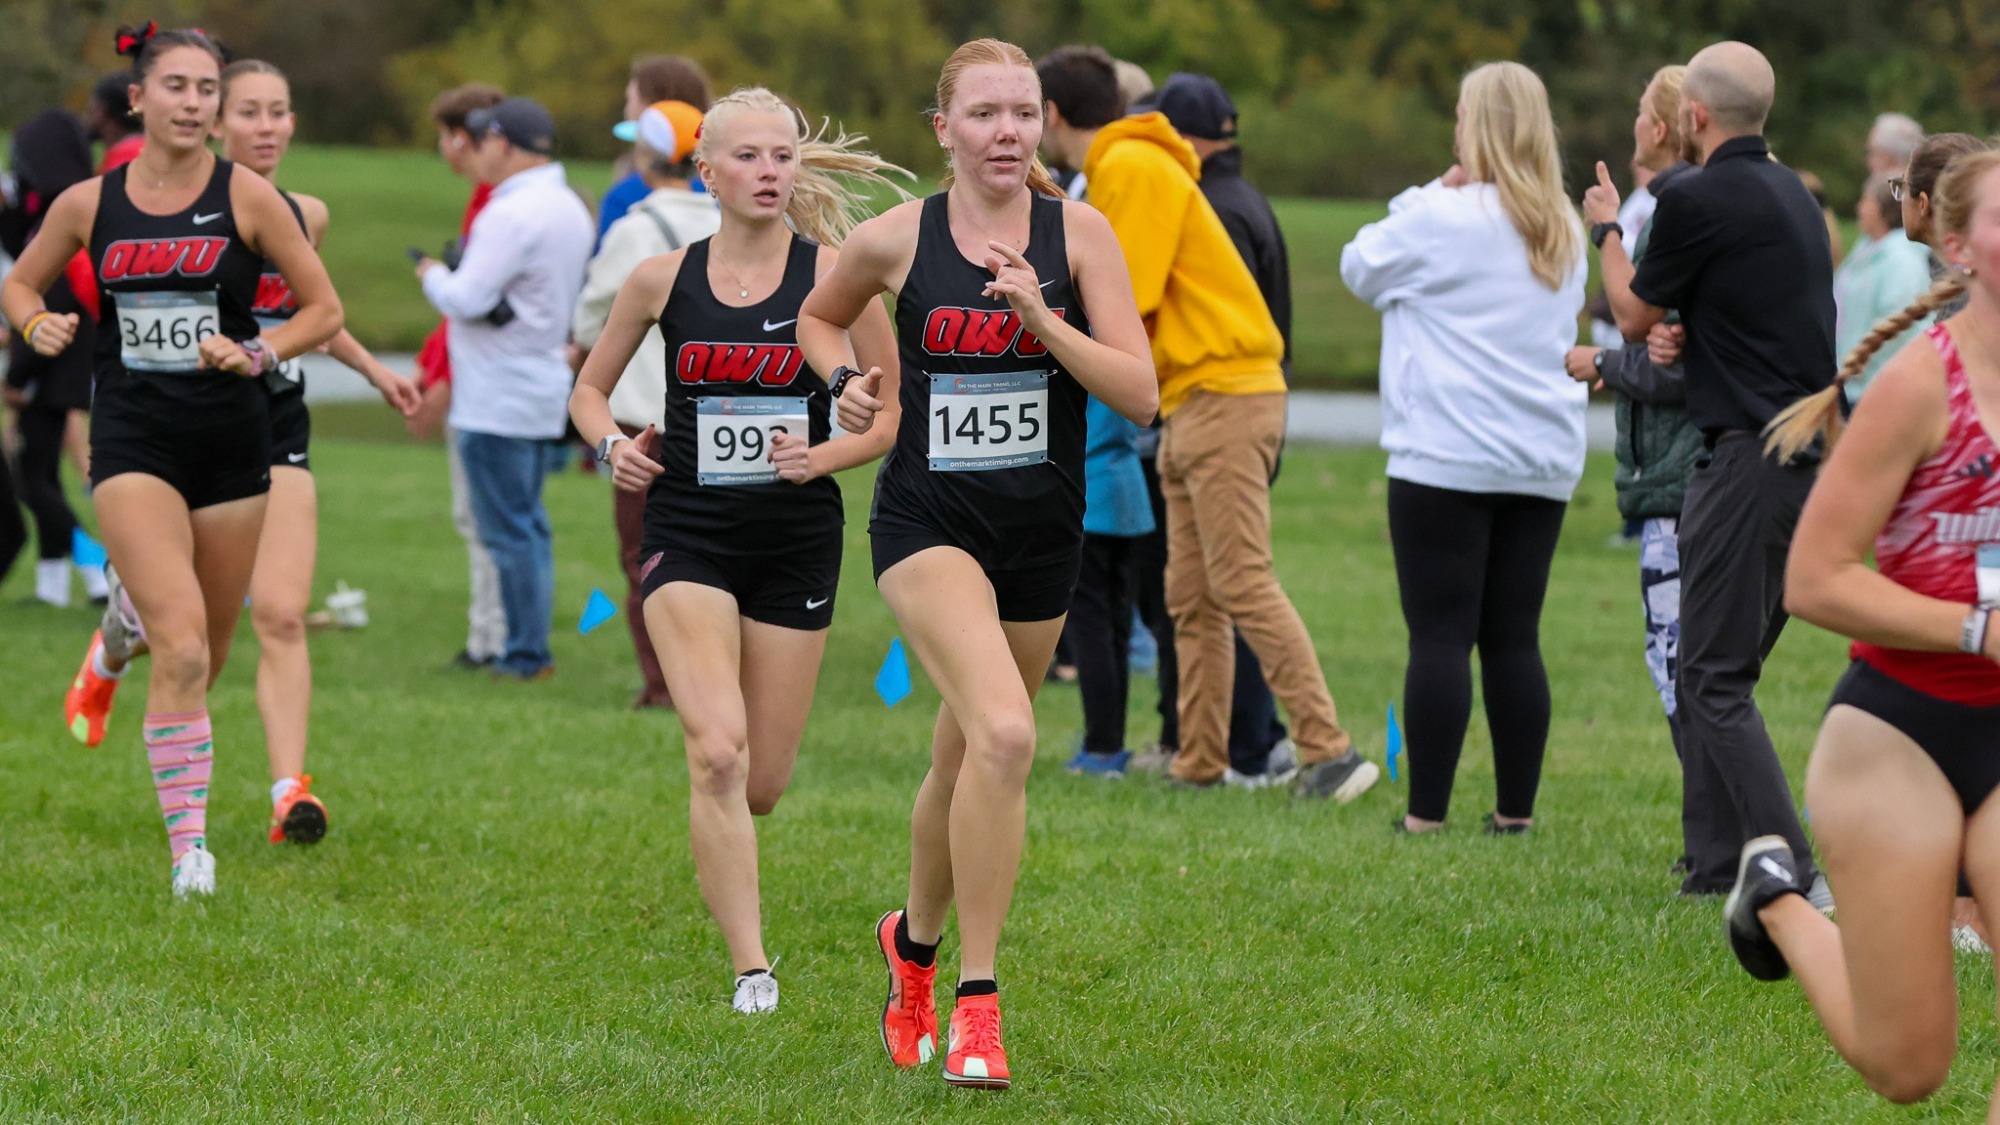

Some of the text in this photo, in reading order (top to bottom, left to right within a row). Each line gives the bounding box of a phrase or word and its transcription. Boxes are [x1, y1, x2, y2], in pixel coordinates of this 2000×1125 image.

[100, 236, 230, 283] OWU
[122, 315, 215, 350] 3466
[676, 341, 804, 387] OWU
[713, 425, 788, 462] 99
[935, 402, 1040, 445] 1455
[949, 456, 1029, 468] onthemarktiming.com
